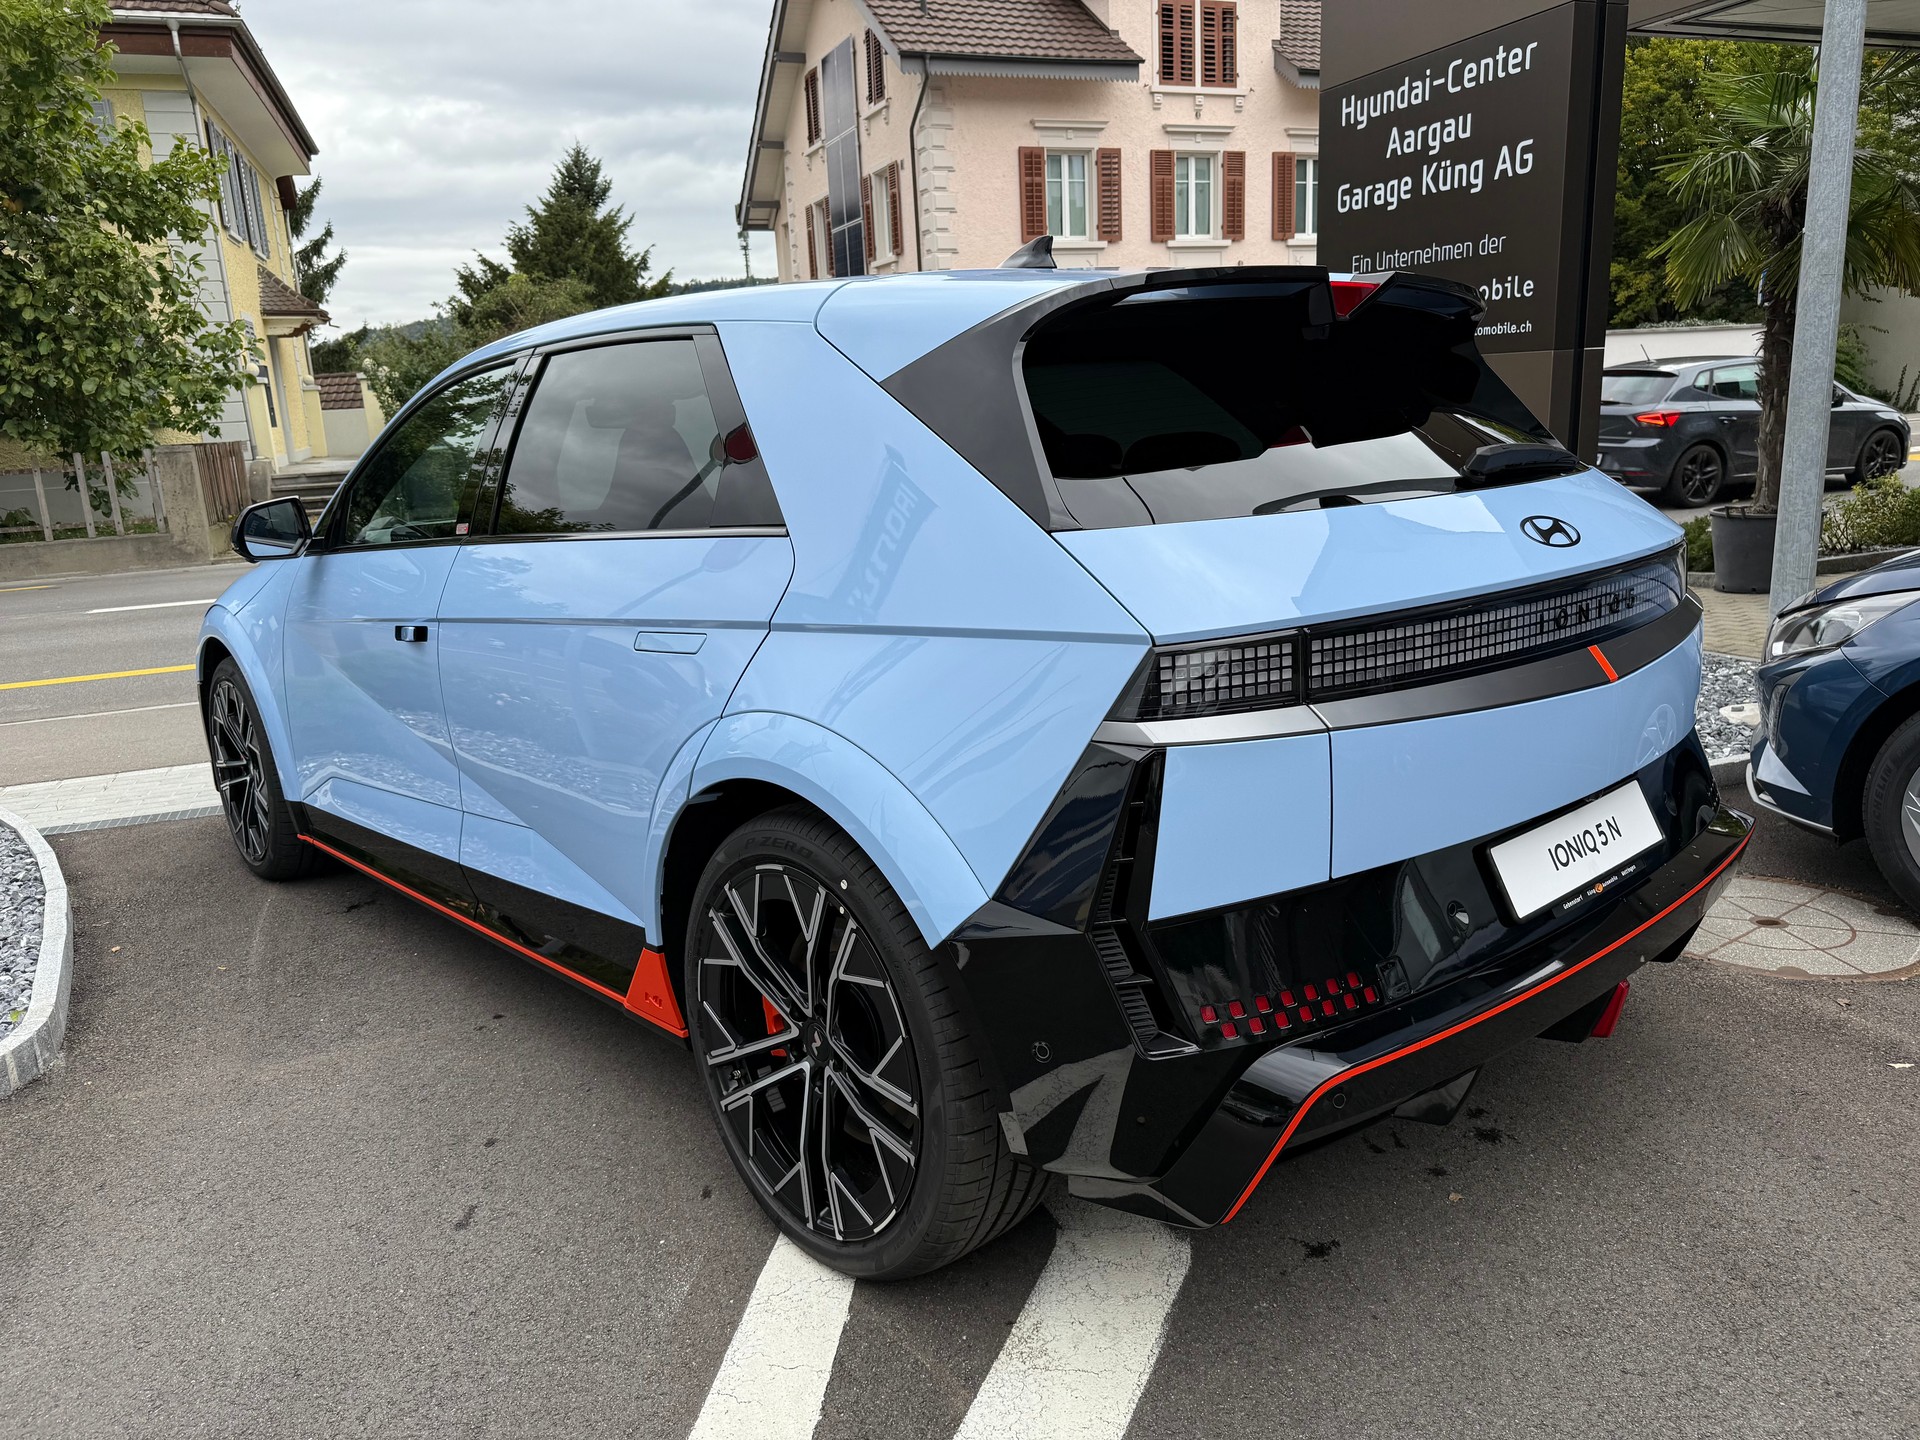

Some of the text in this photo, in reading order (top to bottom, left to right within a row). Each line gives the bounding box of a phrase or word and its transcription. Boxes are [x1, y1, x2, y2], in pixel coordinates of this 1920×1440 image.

[1341, 41, 1538, 130] Hyundai-Center
[1385, 112, 1472, 159] Aargau
[1337, 138, 1534, 214] Garage Küng AG
[1352, 233, 1507, 275] Ein Unternehmen der
[1479, 274, 1535, 301] obile
[1474, 320, 1532, 336] omobile.ch
[1547, 815, 1623, 871] IONIQ 5 N
